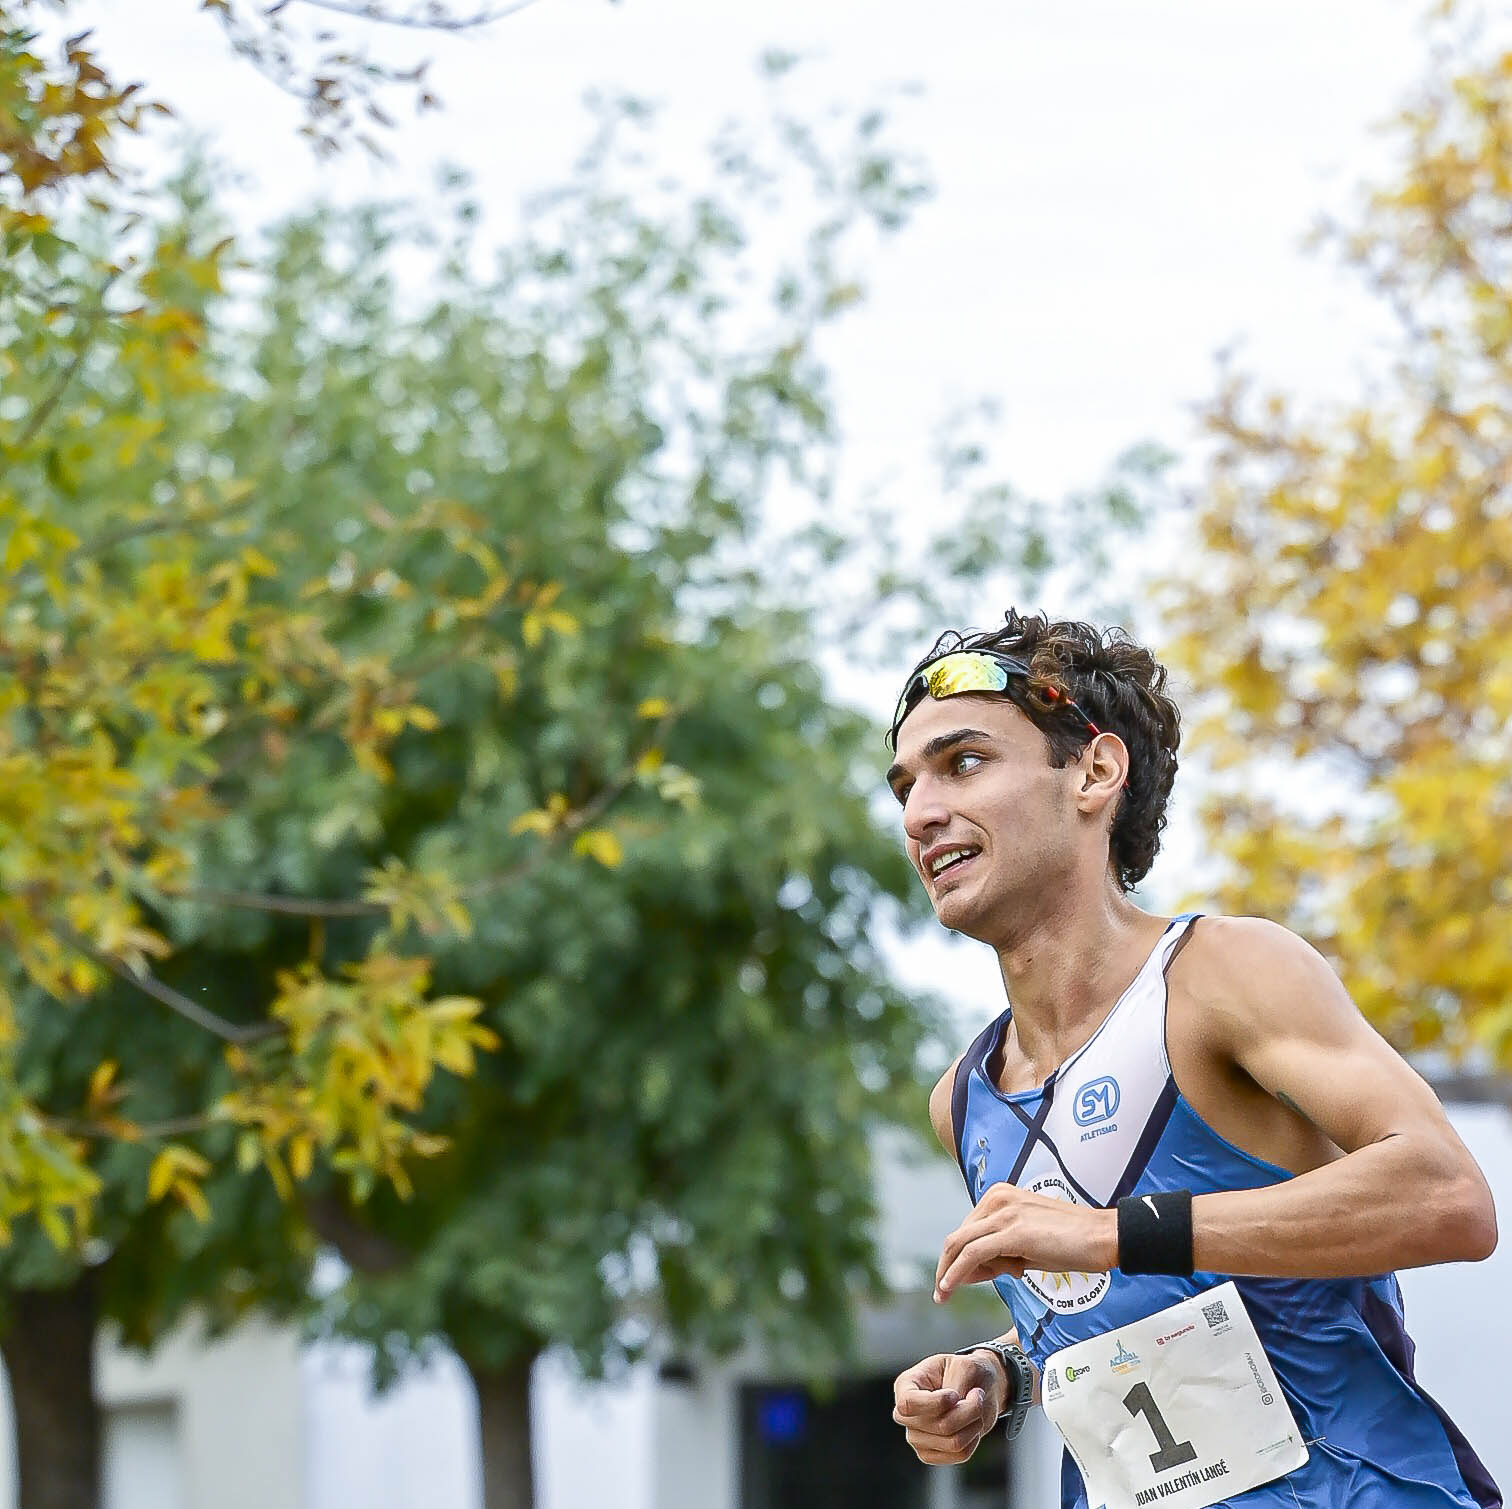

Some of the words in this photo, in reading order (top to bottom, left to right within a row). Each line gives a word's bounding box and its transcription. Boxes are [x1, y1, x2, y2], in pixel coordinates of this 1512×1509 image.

[1080, 1124, 1117, 1142] ATLETISMO
[1033, 1182, 1042, 1192] DE
[1056, 1300, 1074, 1308] CON
[1077, 1279, 1106, 1305] GLORIA
[1122, 1382, 1198, 1473] 1
[1135, 1488, 1158, 1506] JUAN
[1157, 1470, 1201, 1497] VALENTÍN
[1200, 1458, 1230, 1482] LANGÉ
